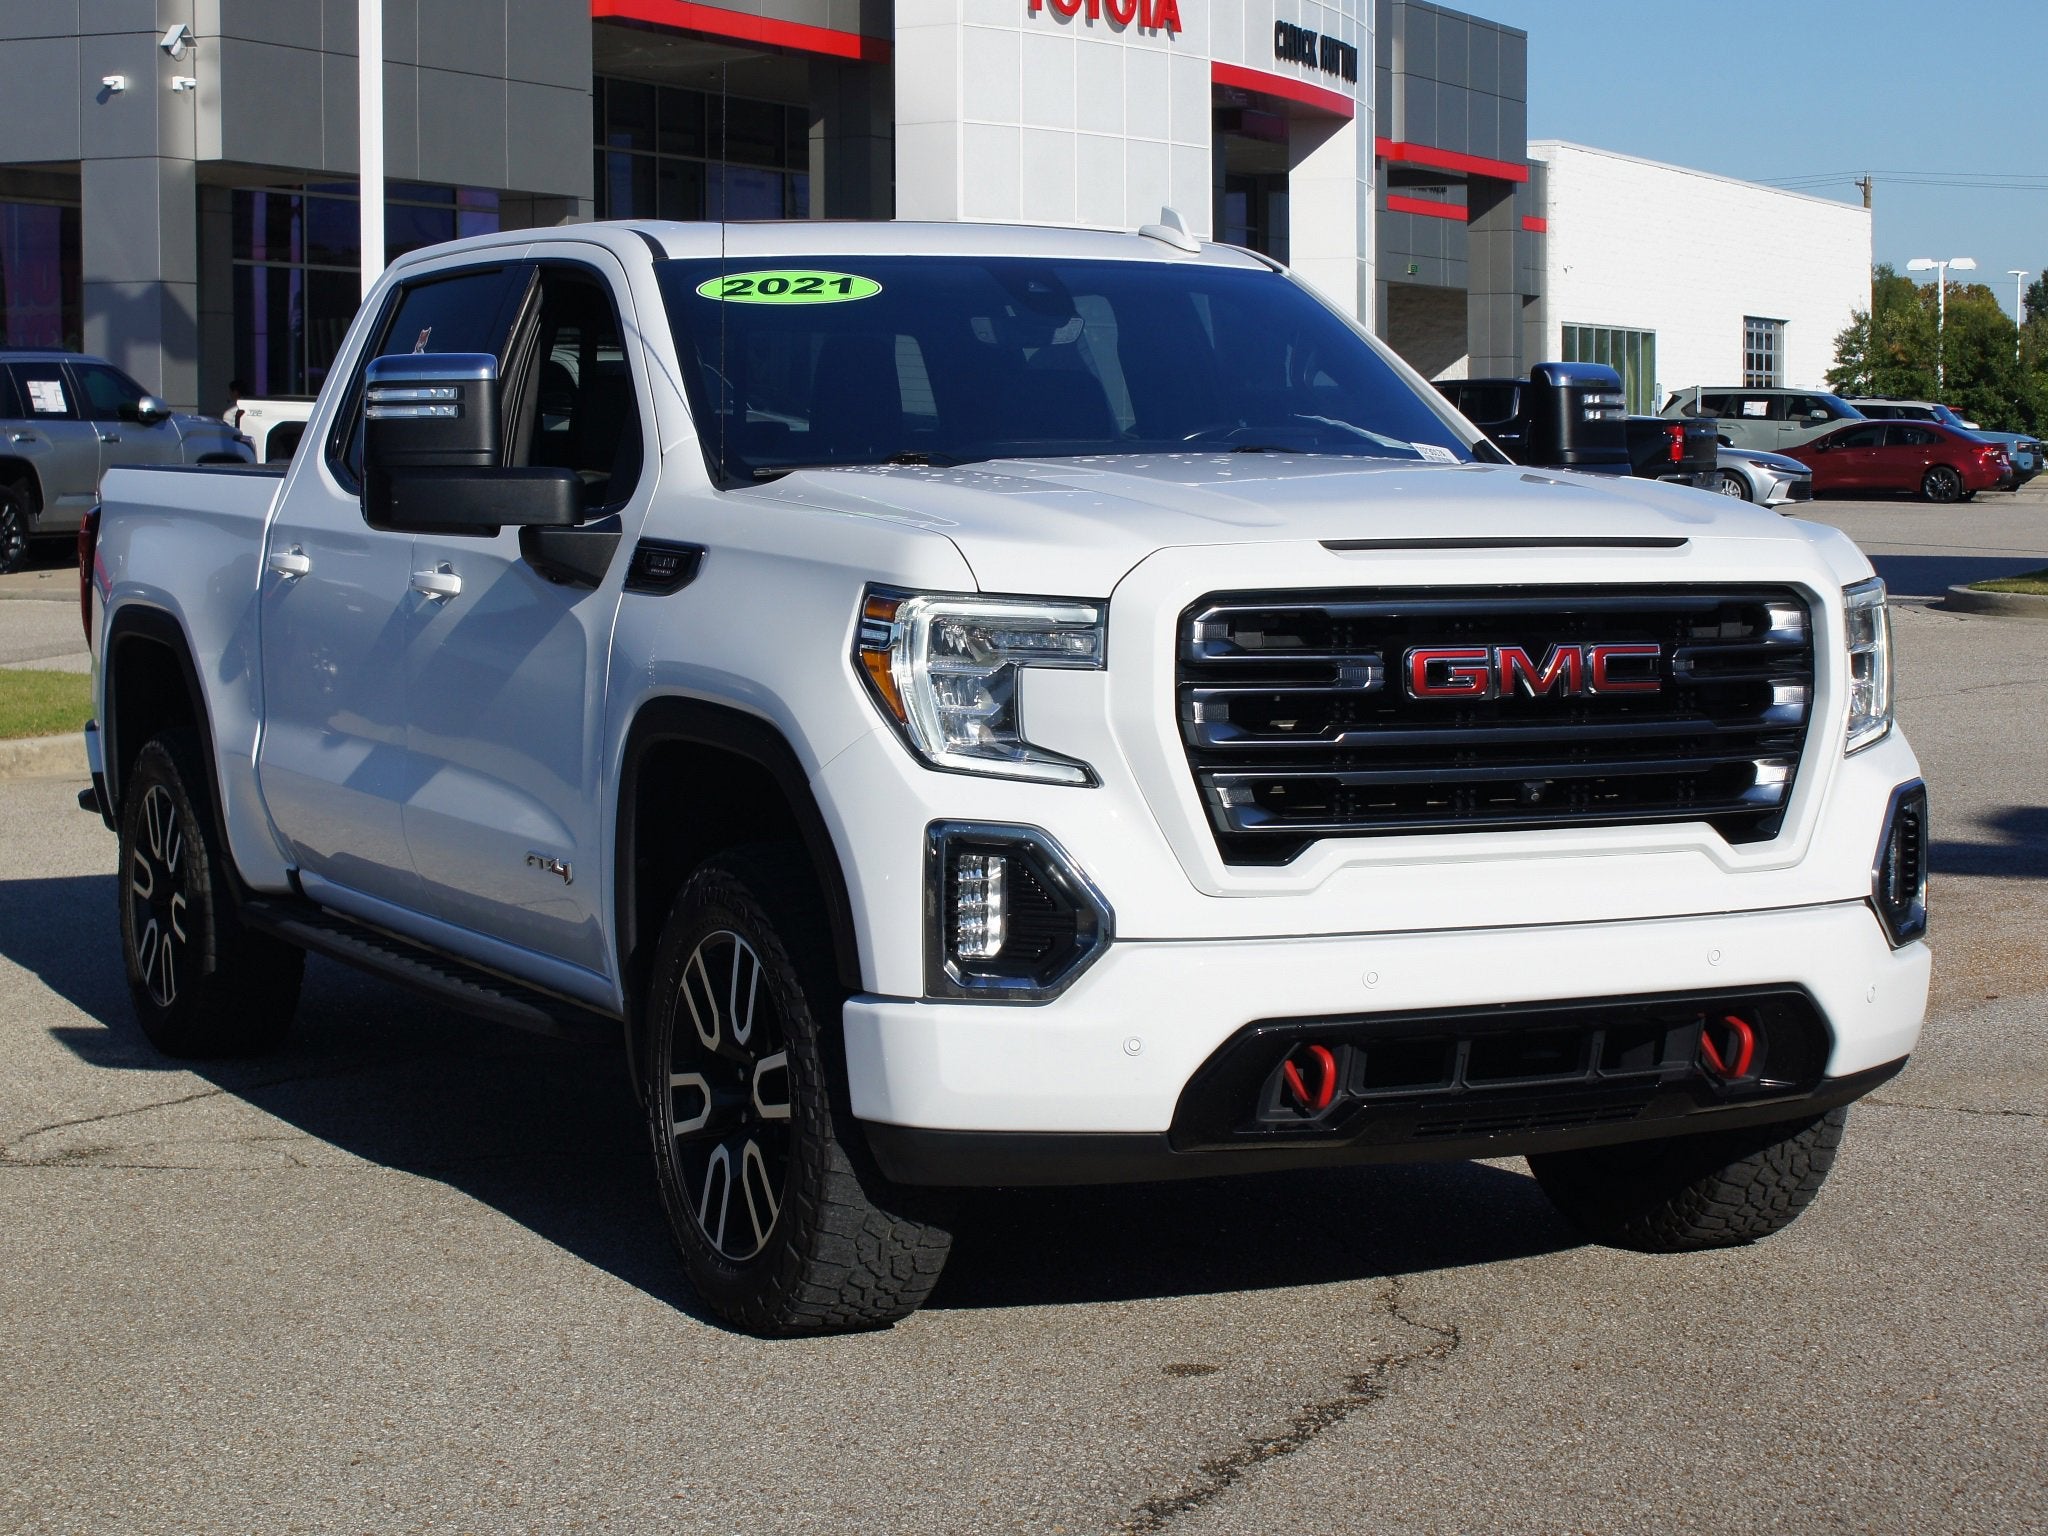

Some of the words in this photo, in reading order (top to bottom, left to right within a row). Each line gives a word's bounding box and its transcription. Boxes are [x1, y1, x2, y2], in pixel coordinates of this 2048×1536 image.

[1029, 0, 1183, 33] OTA
[1274, 20, 1318, 70] CHUCK
[720, 277, 855, 297] 2021
[1403, 643, 1661, 699] GMC
